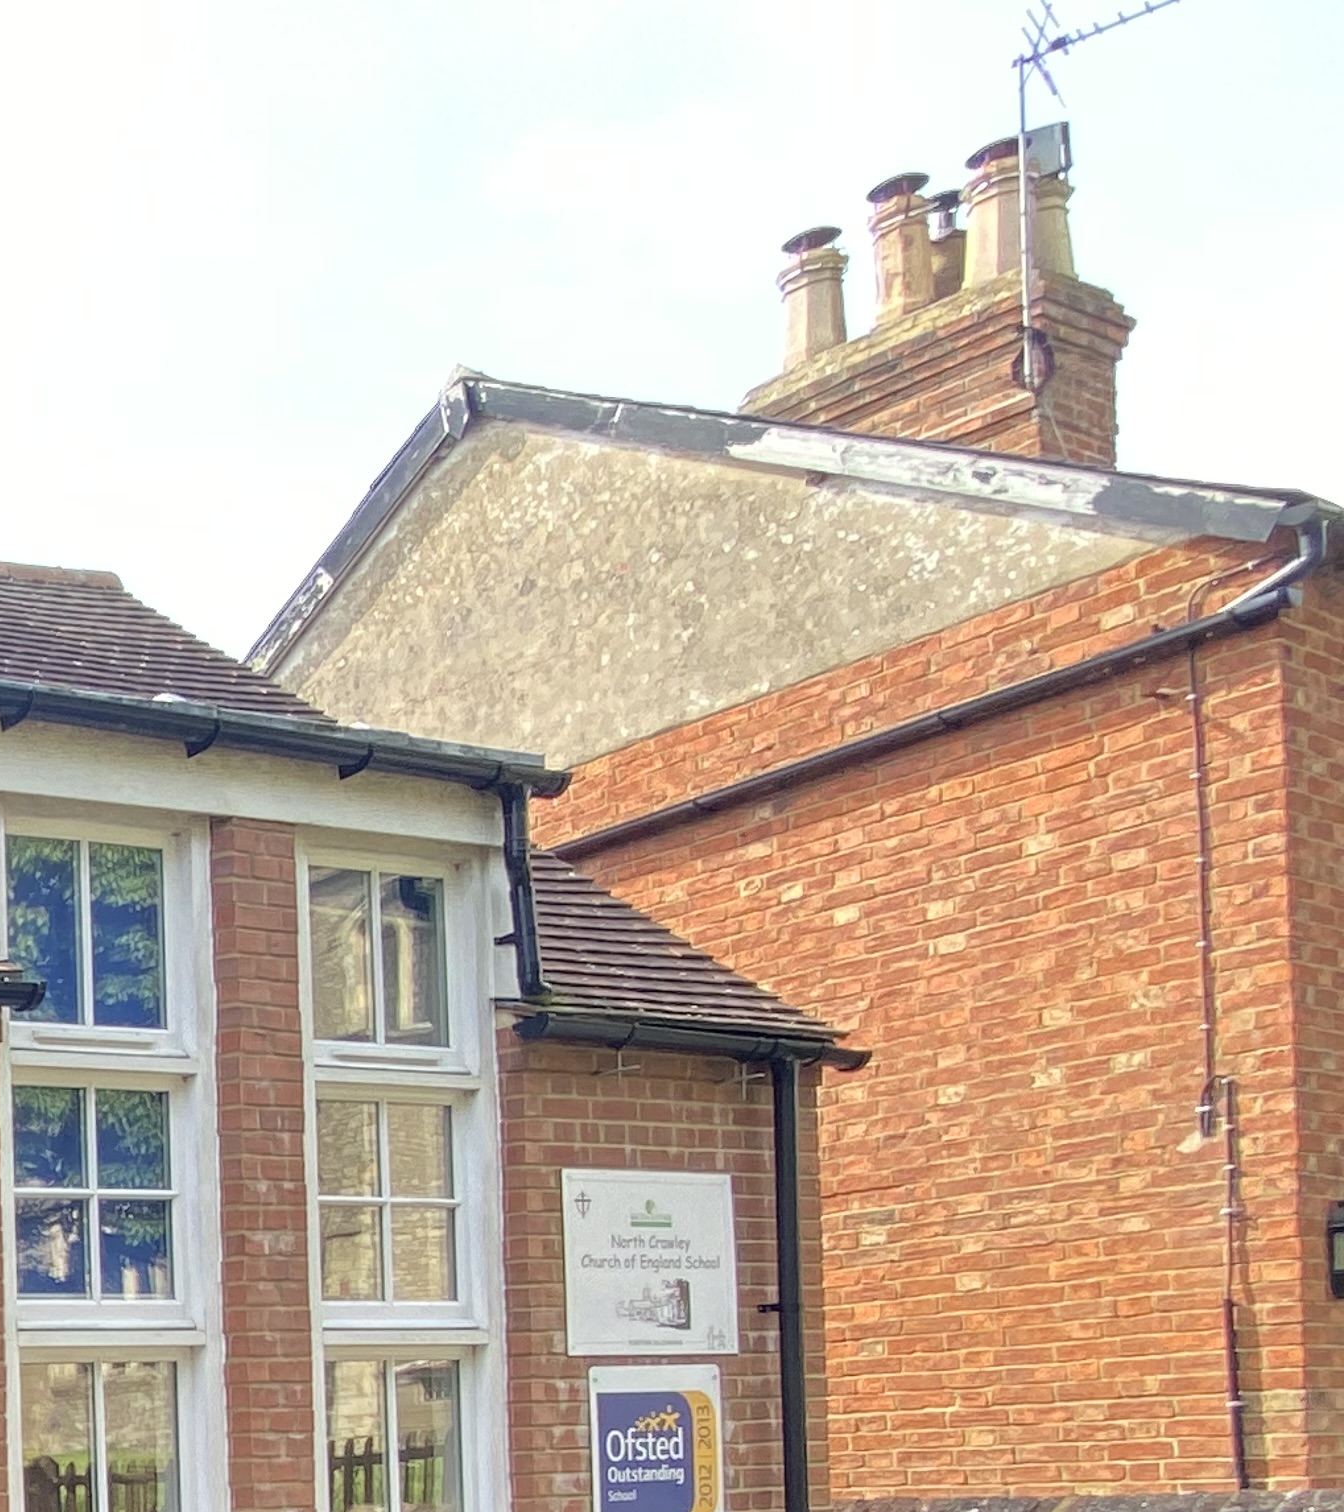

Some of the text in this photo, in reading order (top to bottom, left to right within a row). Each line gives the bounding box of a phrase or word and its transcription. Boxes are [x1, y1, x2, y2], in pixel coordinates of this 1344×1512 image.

[611, 1234, 691, 1252] North Crawley
[581, 1254, 721, 1273] Church of England School
[605, 1427, 684, 1462] Ofsted
[696, 1404, 714, 1507] 2012 2013
[607, 1464, 685, 1485] Outstanding
[607, 1488, 638, 1502] School
